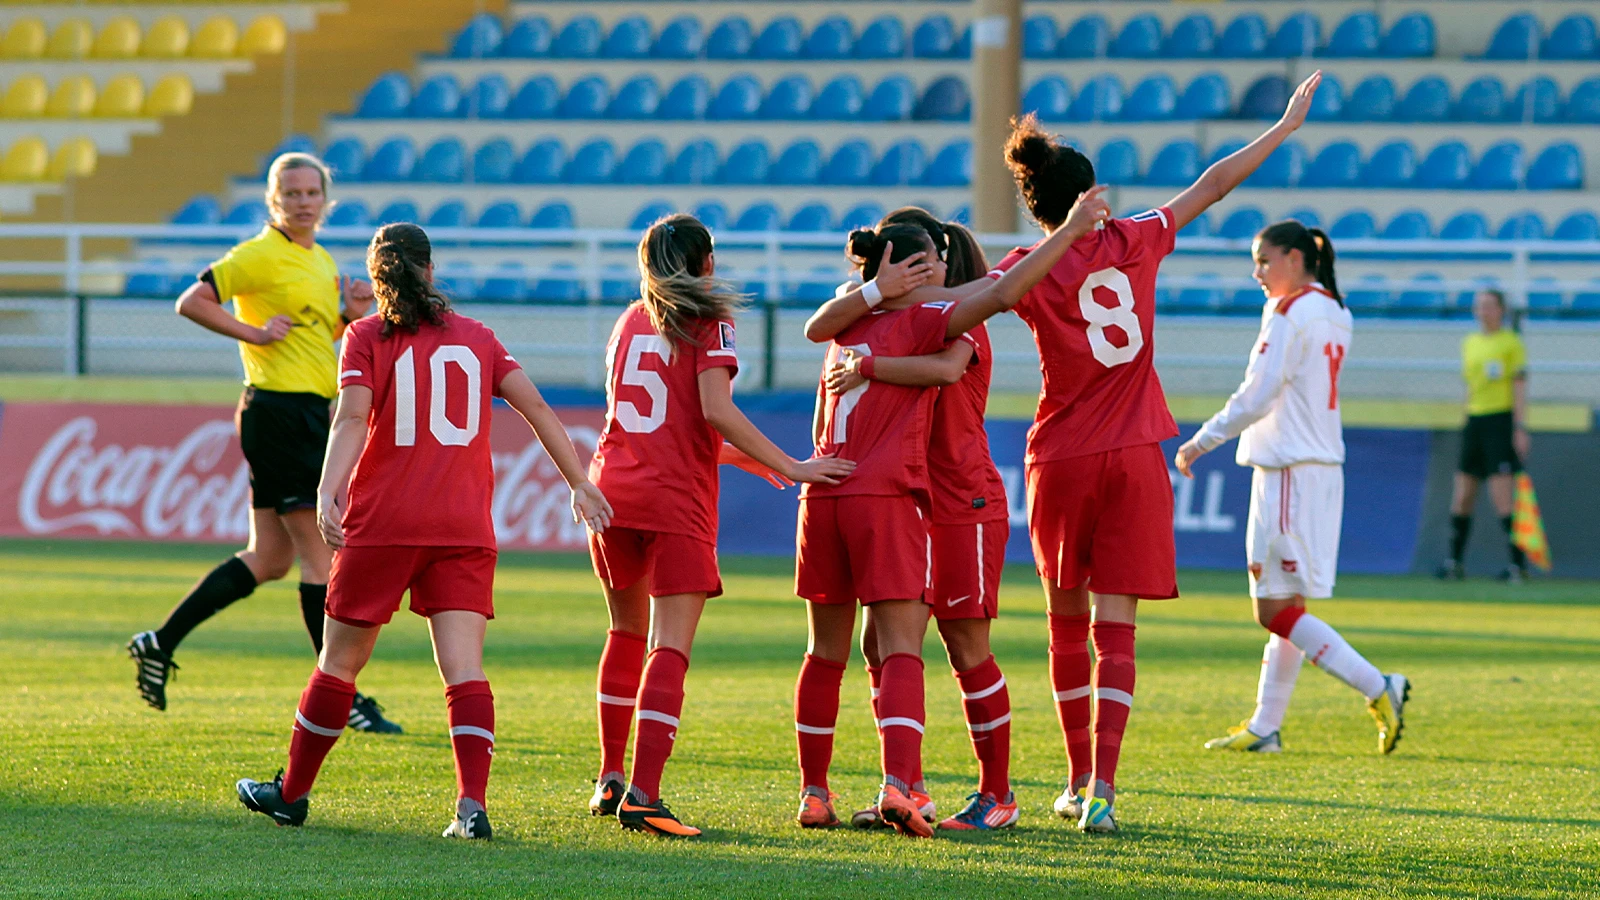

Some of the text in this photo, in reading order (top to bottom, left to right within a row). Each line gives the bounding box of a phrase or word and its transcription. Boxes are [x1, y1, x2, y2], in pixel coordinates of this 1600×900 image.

[1078, 266, 1144, 369] 8
[395, 345, 481, 446] 10
[18, 416, 250, 538] Coca-Col
